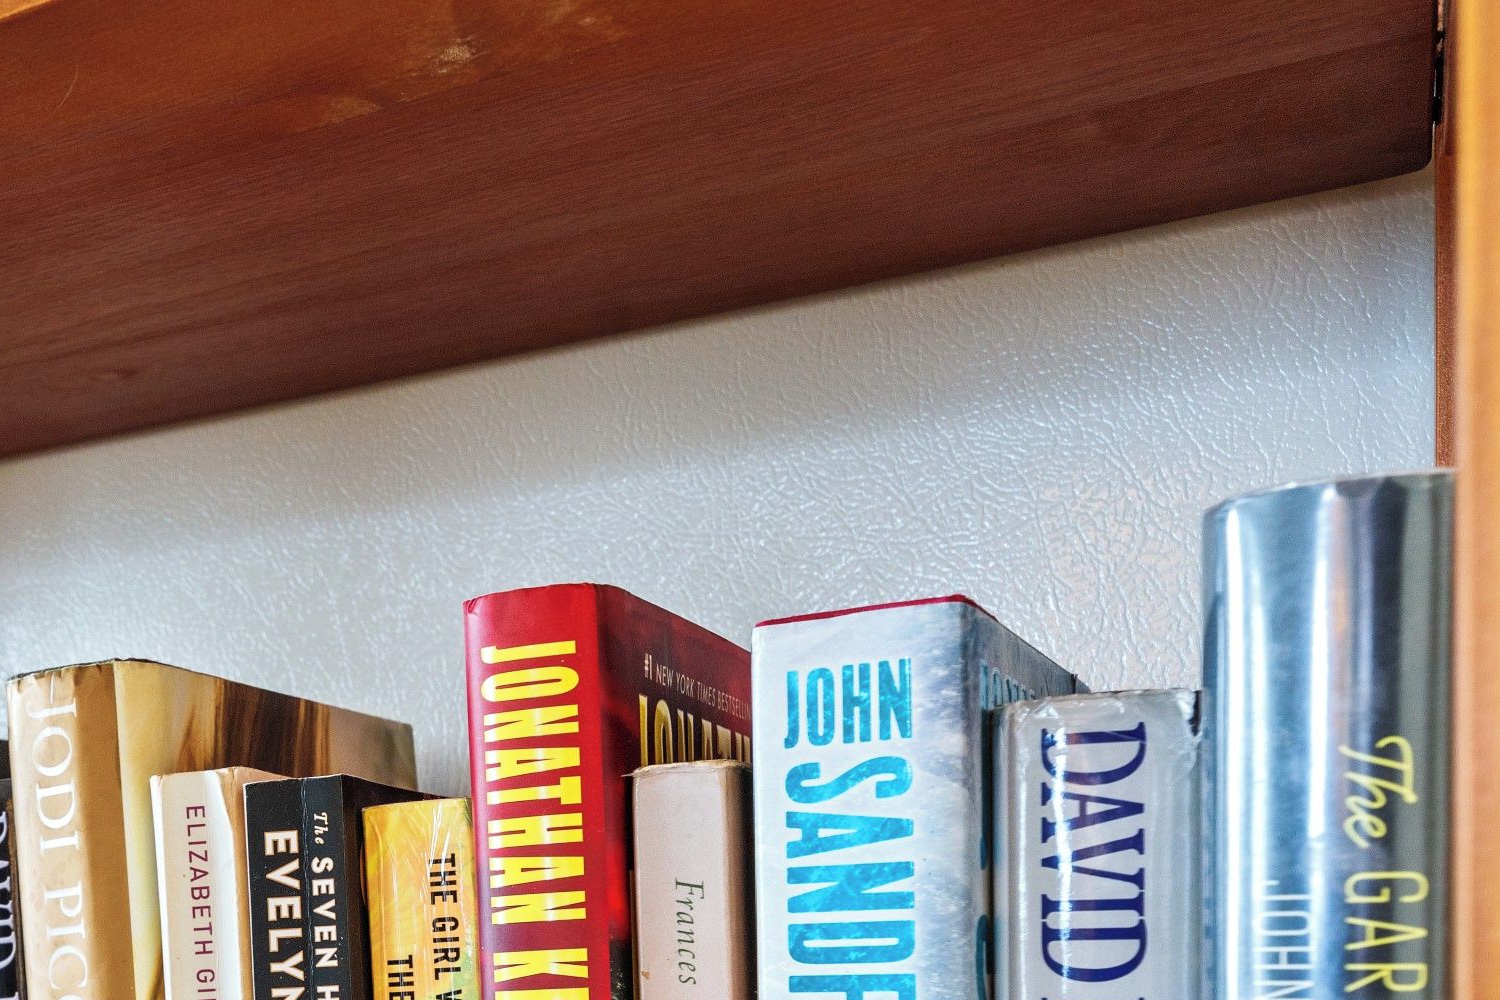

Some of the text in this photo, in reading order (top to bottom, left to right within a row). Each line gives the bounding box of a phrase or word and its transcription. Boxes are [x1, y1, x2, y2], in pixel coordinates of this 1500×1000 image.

[655, 662, 674, 688] NEW
[676, 671, 695, 699] YORK
[697, 681, 716, 708] TIMES
[784, 657, 913, 750] JOHN
[26, 697, 79, 856] JODI
[313, 811, 329, 847] The
[480, 640, 587, 925] JONATHAN
[1339, 735, 1418, 849] The
[186, 804, 214, 957] ELIZABETH
[428, 852, 458, 905] THE
[1041, 721, 1148, 983] DAVID
[311, 856, 340, 969] SEVEN
[430, 915, 461, 981] GIRL
[675, 877, 705, 985] Frances
